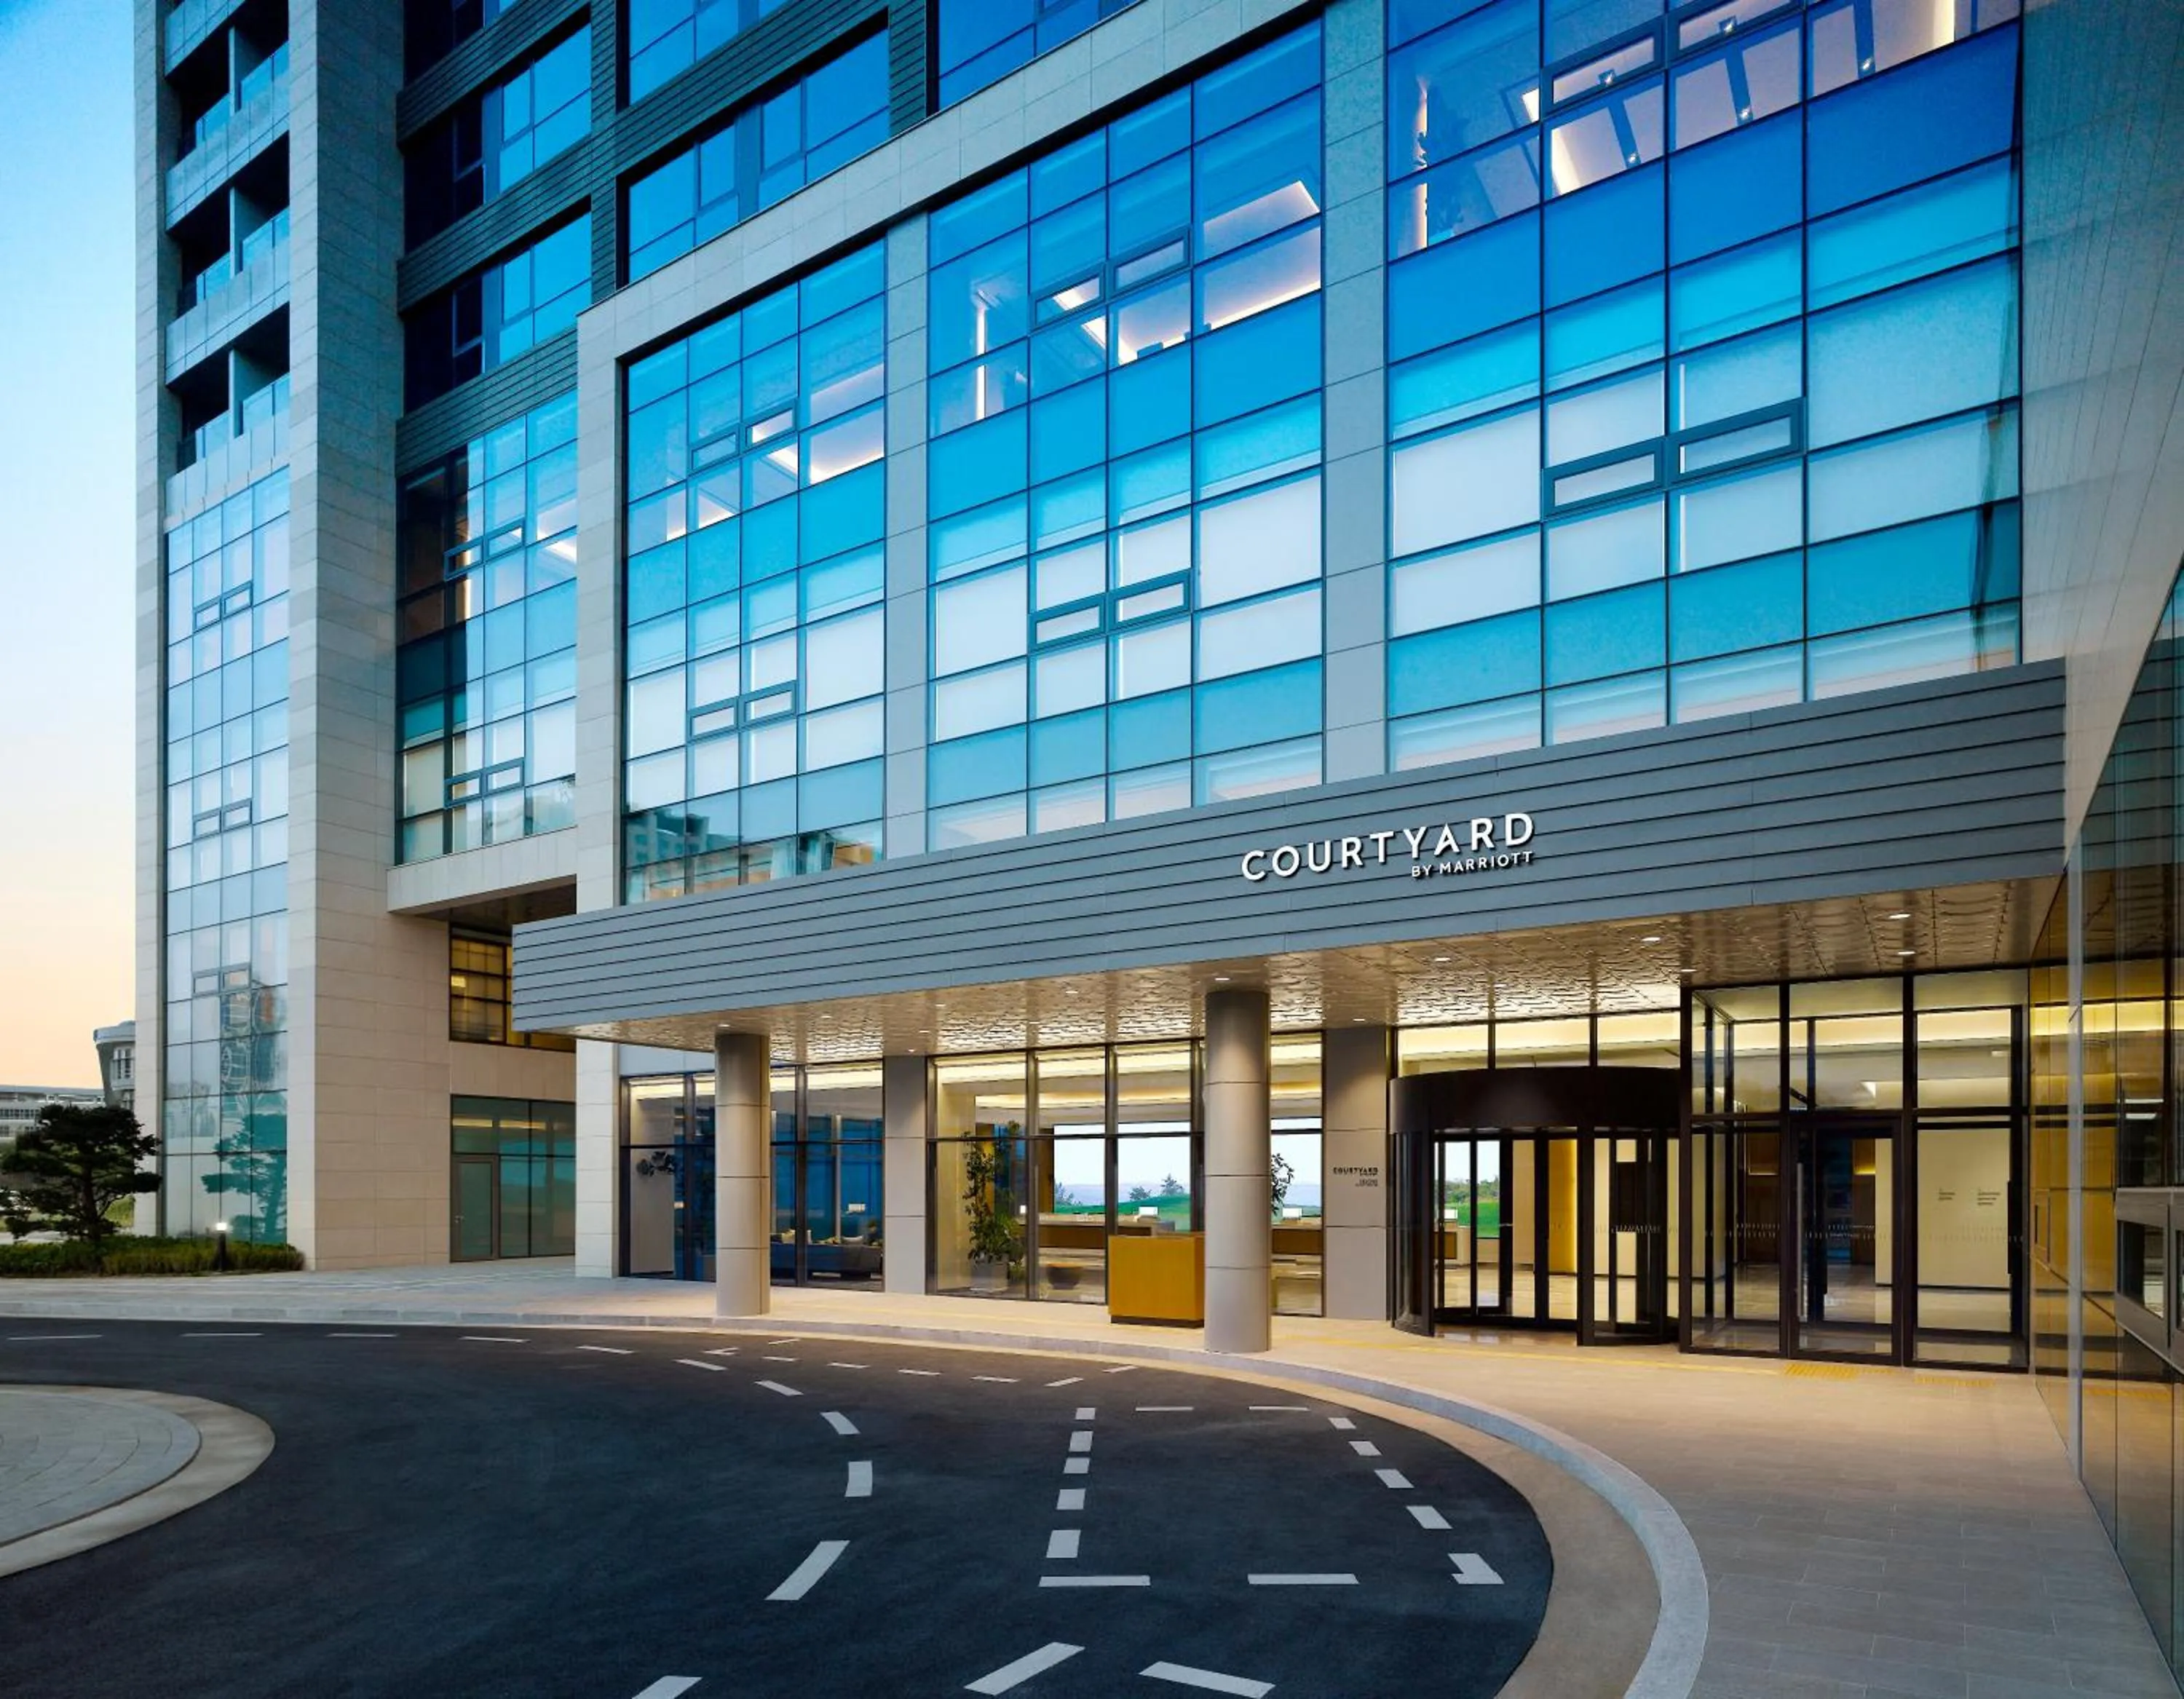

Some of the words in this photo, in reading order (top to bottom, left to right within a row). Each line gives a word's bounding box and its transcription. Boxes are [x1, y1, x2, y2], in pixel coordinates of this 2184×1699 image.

[1241, 813, 1534, 881] COURTYARD
[1411, 864, 1433, 878] BY
[1439, 850, 1533, 874] MARRIOTT
[1333, 1167, 1378, 1175] COURTYARD
